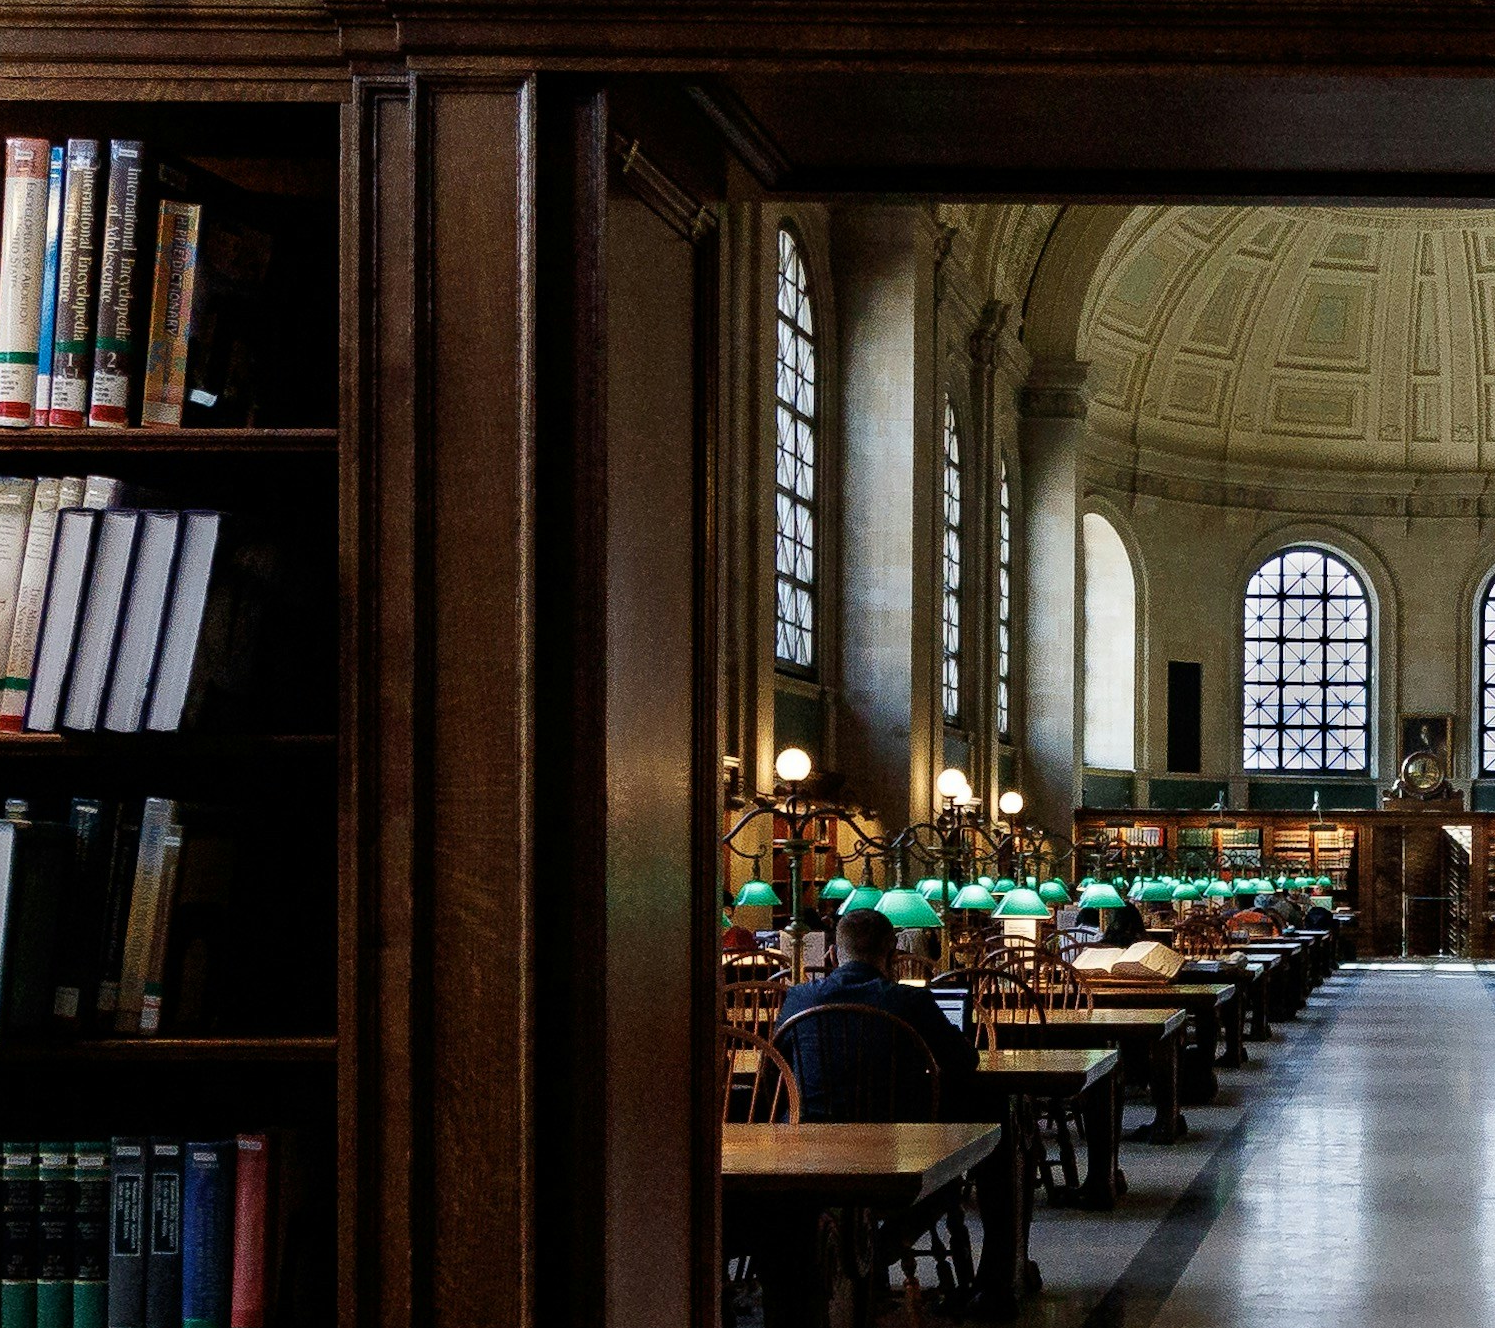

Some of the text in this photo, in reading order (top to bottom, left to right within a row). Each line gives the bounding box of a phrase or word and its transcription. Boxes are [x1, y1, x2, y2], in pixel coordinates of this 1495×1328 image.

[60, 225, 75, 302] Adolescence
[104, 205, 121, 303] of Adolescence
[114, 167, 142, 342] International Encyclopedia
[73, 256, 94, 342] Encyclopedia
[166, 259, 186, 336] DICTIONARY
[106, 351, 117, 368] 2
